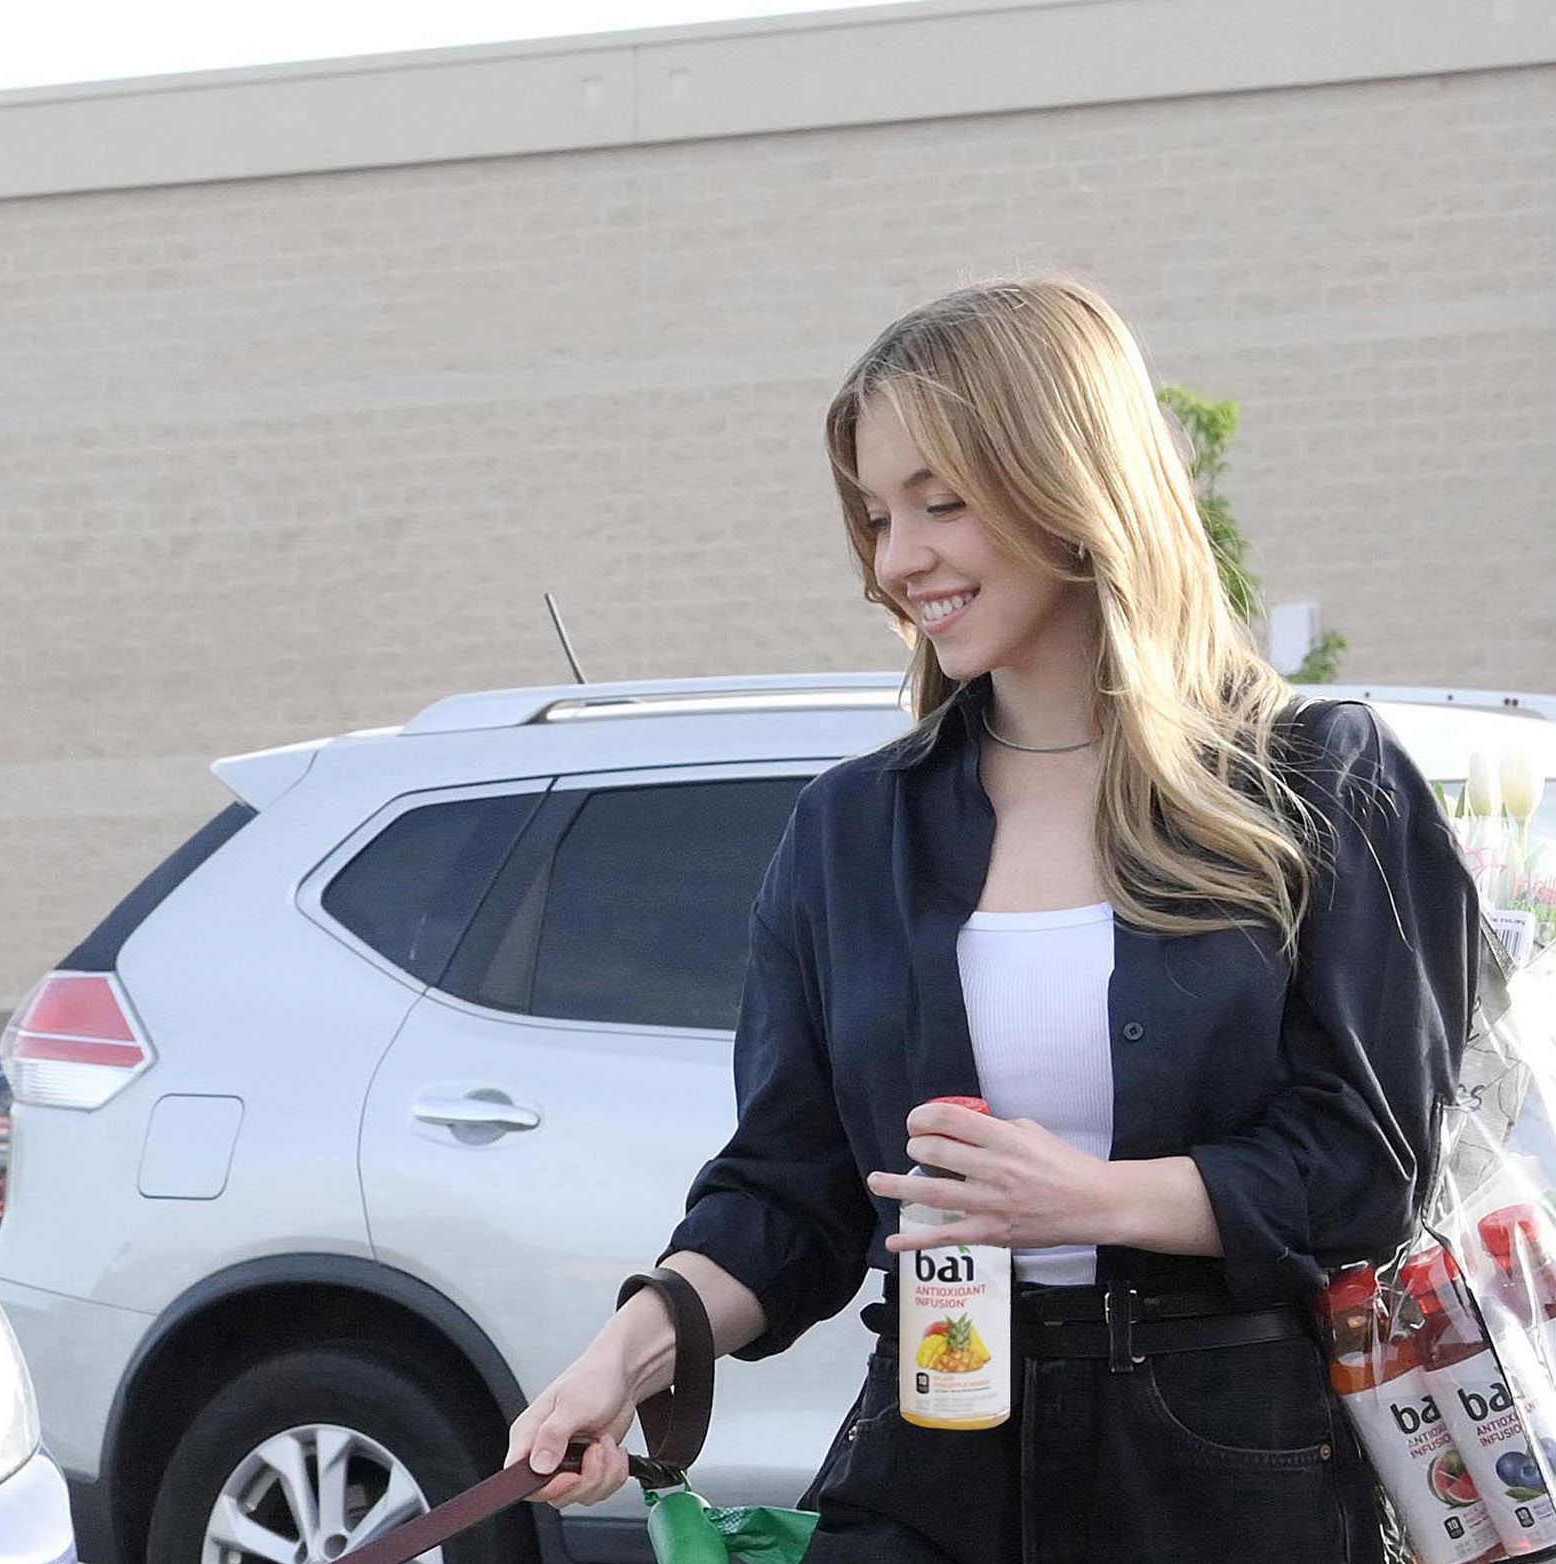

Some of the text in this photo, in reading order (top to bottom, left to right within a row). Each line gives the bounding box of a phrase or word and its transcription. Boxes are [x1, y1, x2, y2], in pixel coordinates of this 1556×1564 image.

[915, 1248, 974, 1283] bai
[915, 1284, 986, 1297] ANTIOXIDANT
[915, 1296, 966, 1309] INFUSION
[1390, 1394, 1442, 1435] ba
[1410, 1432, 1452, 1459] INFUSIO
[1480, 1424, 1523, 1447] INFUSIO
